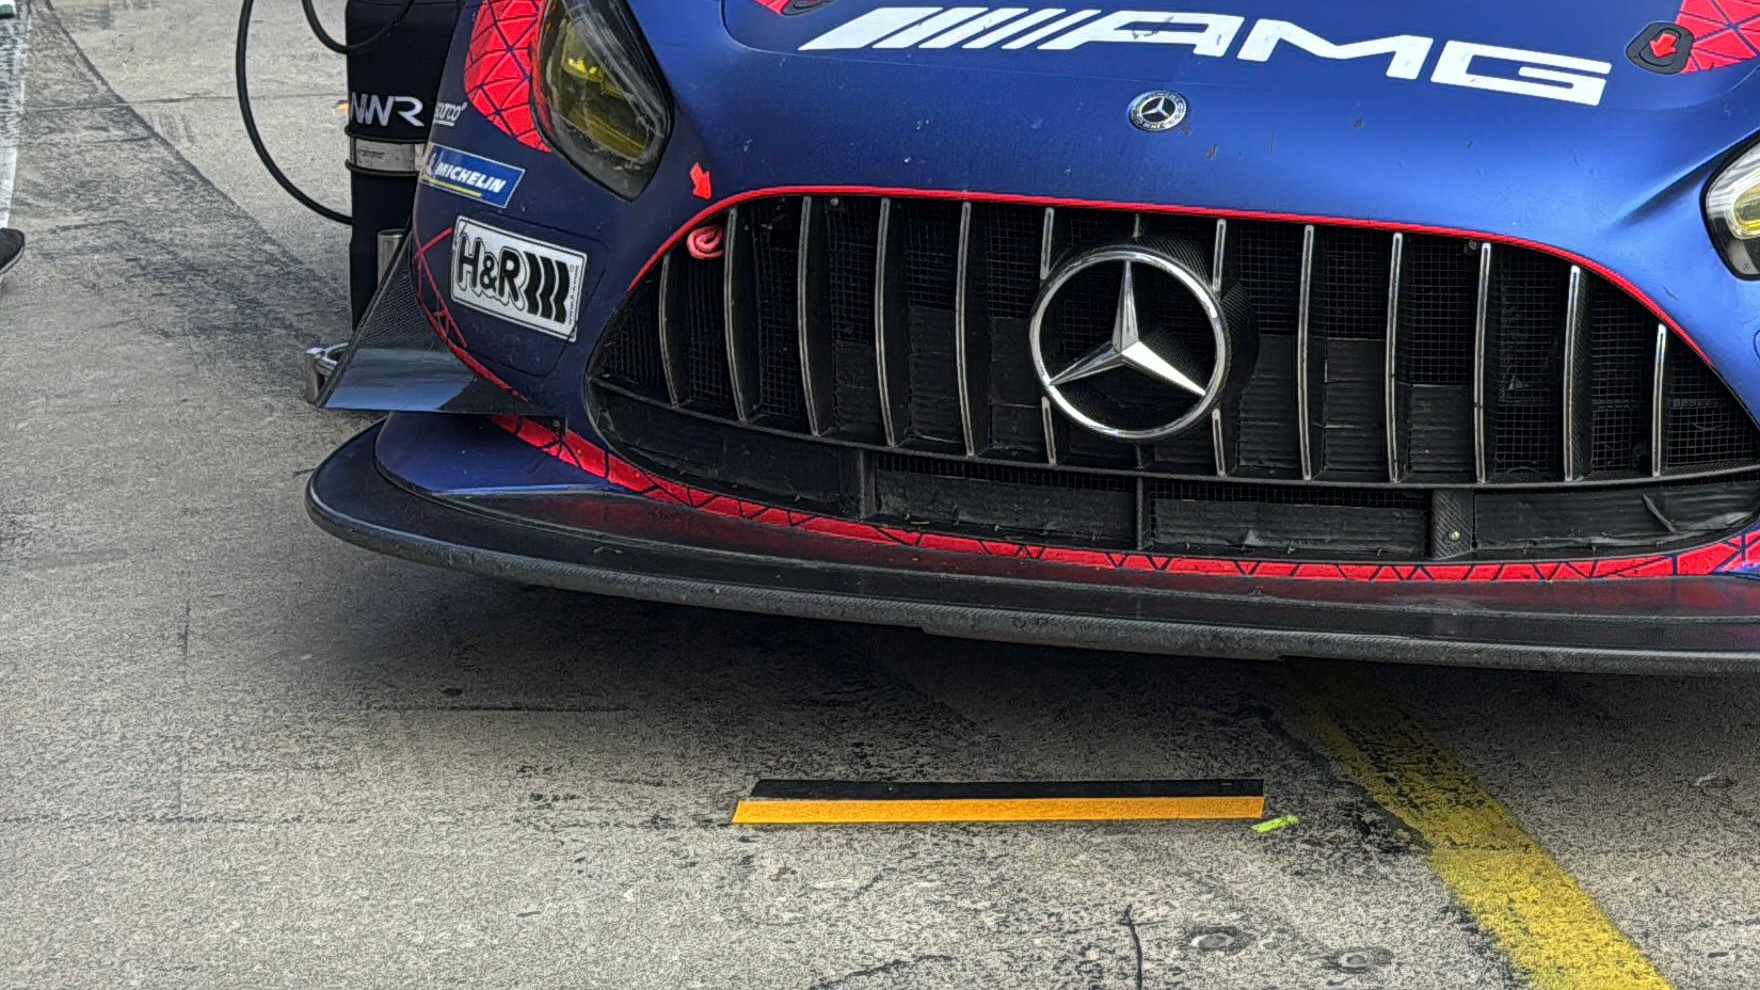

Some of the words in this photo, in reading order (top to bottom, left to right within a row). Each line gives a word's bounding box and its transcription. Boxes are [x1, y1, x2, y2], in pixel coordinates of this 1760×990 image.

[1037, 8, 1613, 107] AMG
[436, 161, 507, 193] MICHELIN
[457, 234, 522, 303] H&R
